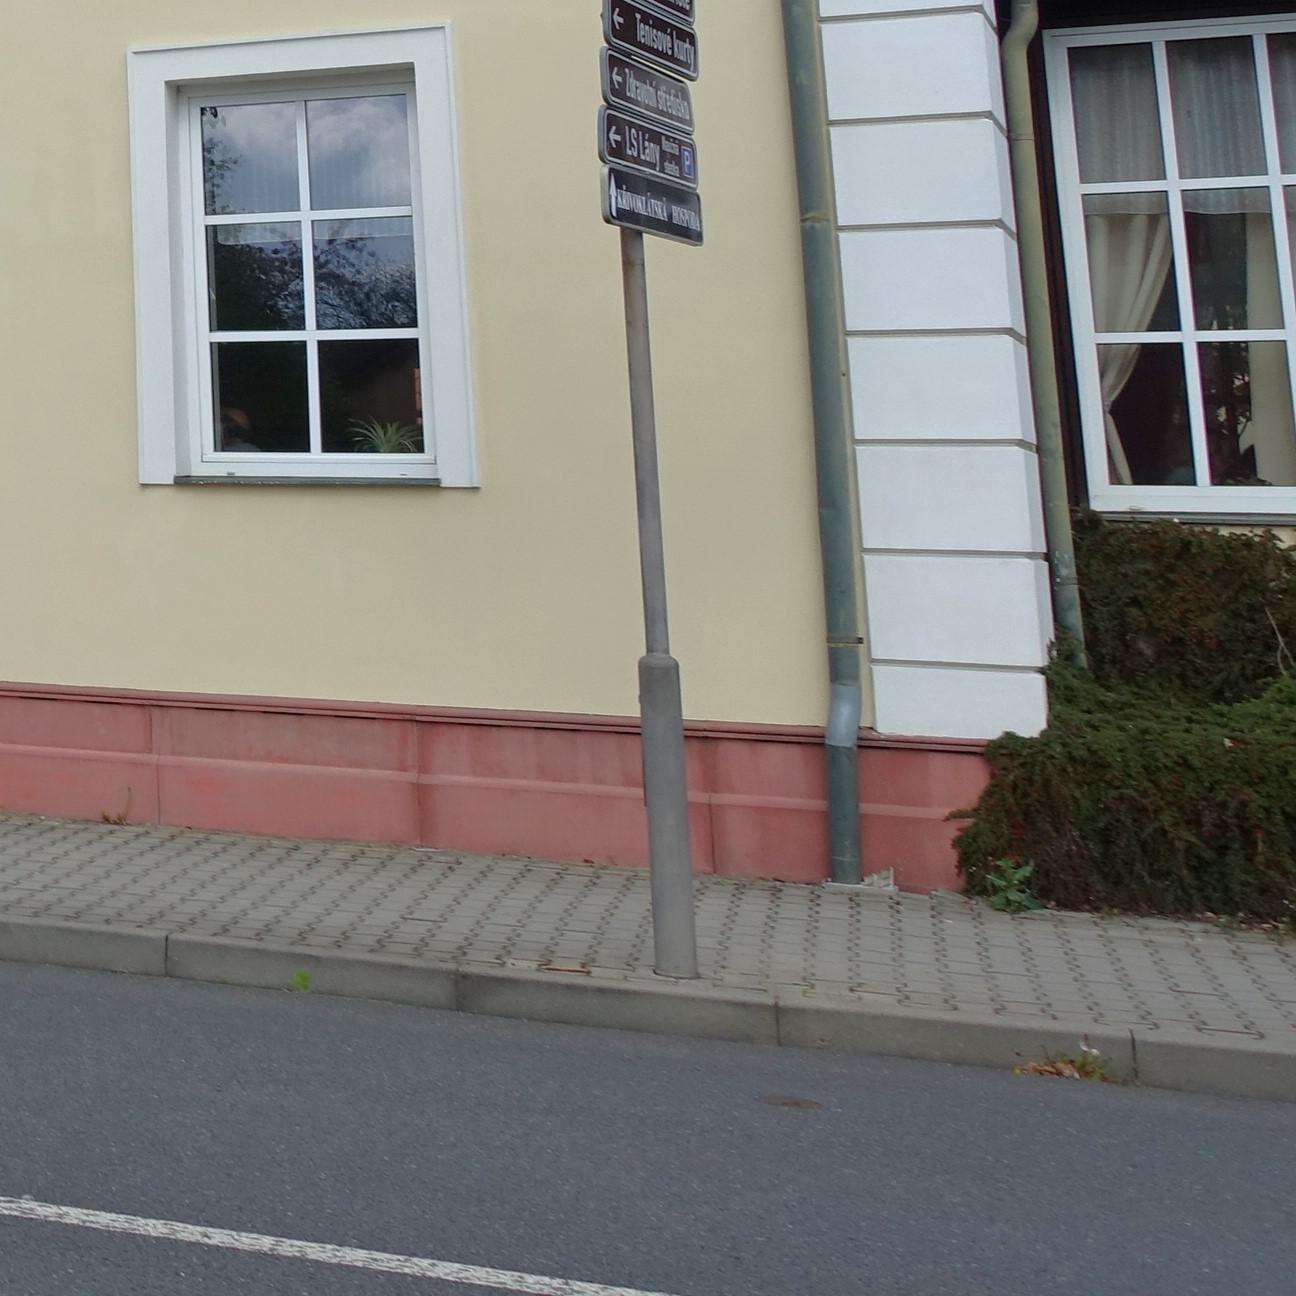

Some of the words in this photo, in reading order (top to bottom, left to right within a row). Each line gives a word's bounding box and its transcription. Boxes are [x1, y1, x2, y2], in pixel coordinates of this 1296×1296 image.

[634, 12, 672, 55] Tenisové
[672, 30, 695, 72] kurty
[624, 68, 658, 108] Zdravotní
[625, 125, 638, 157] LS
[639, 130, 661, 171] Lány
